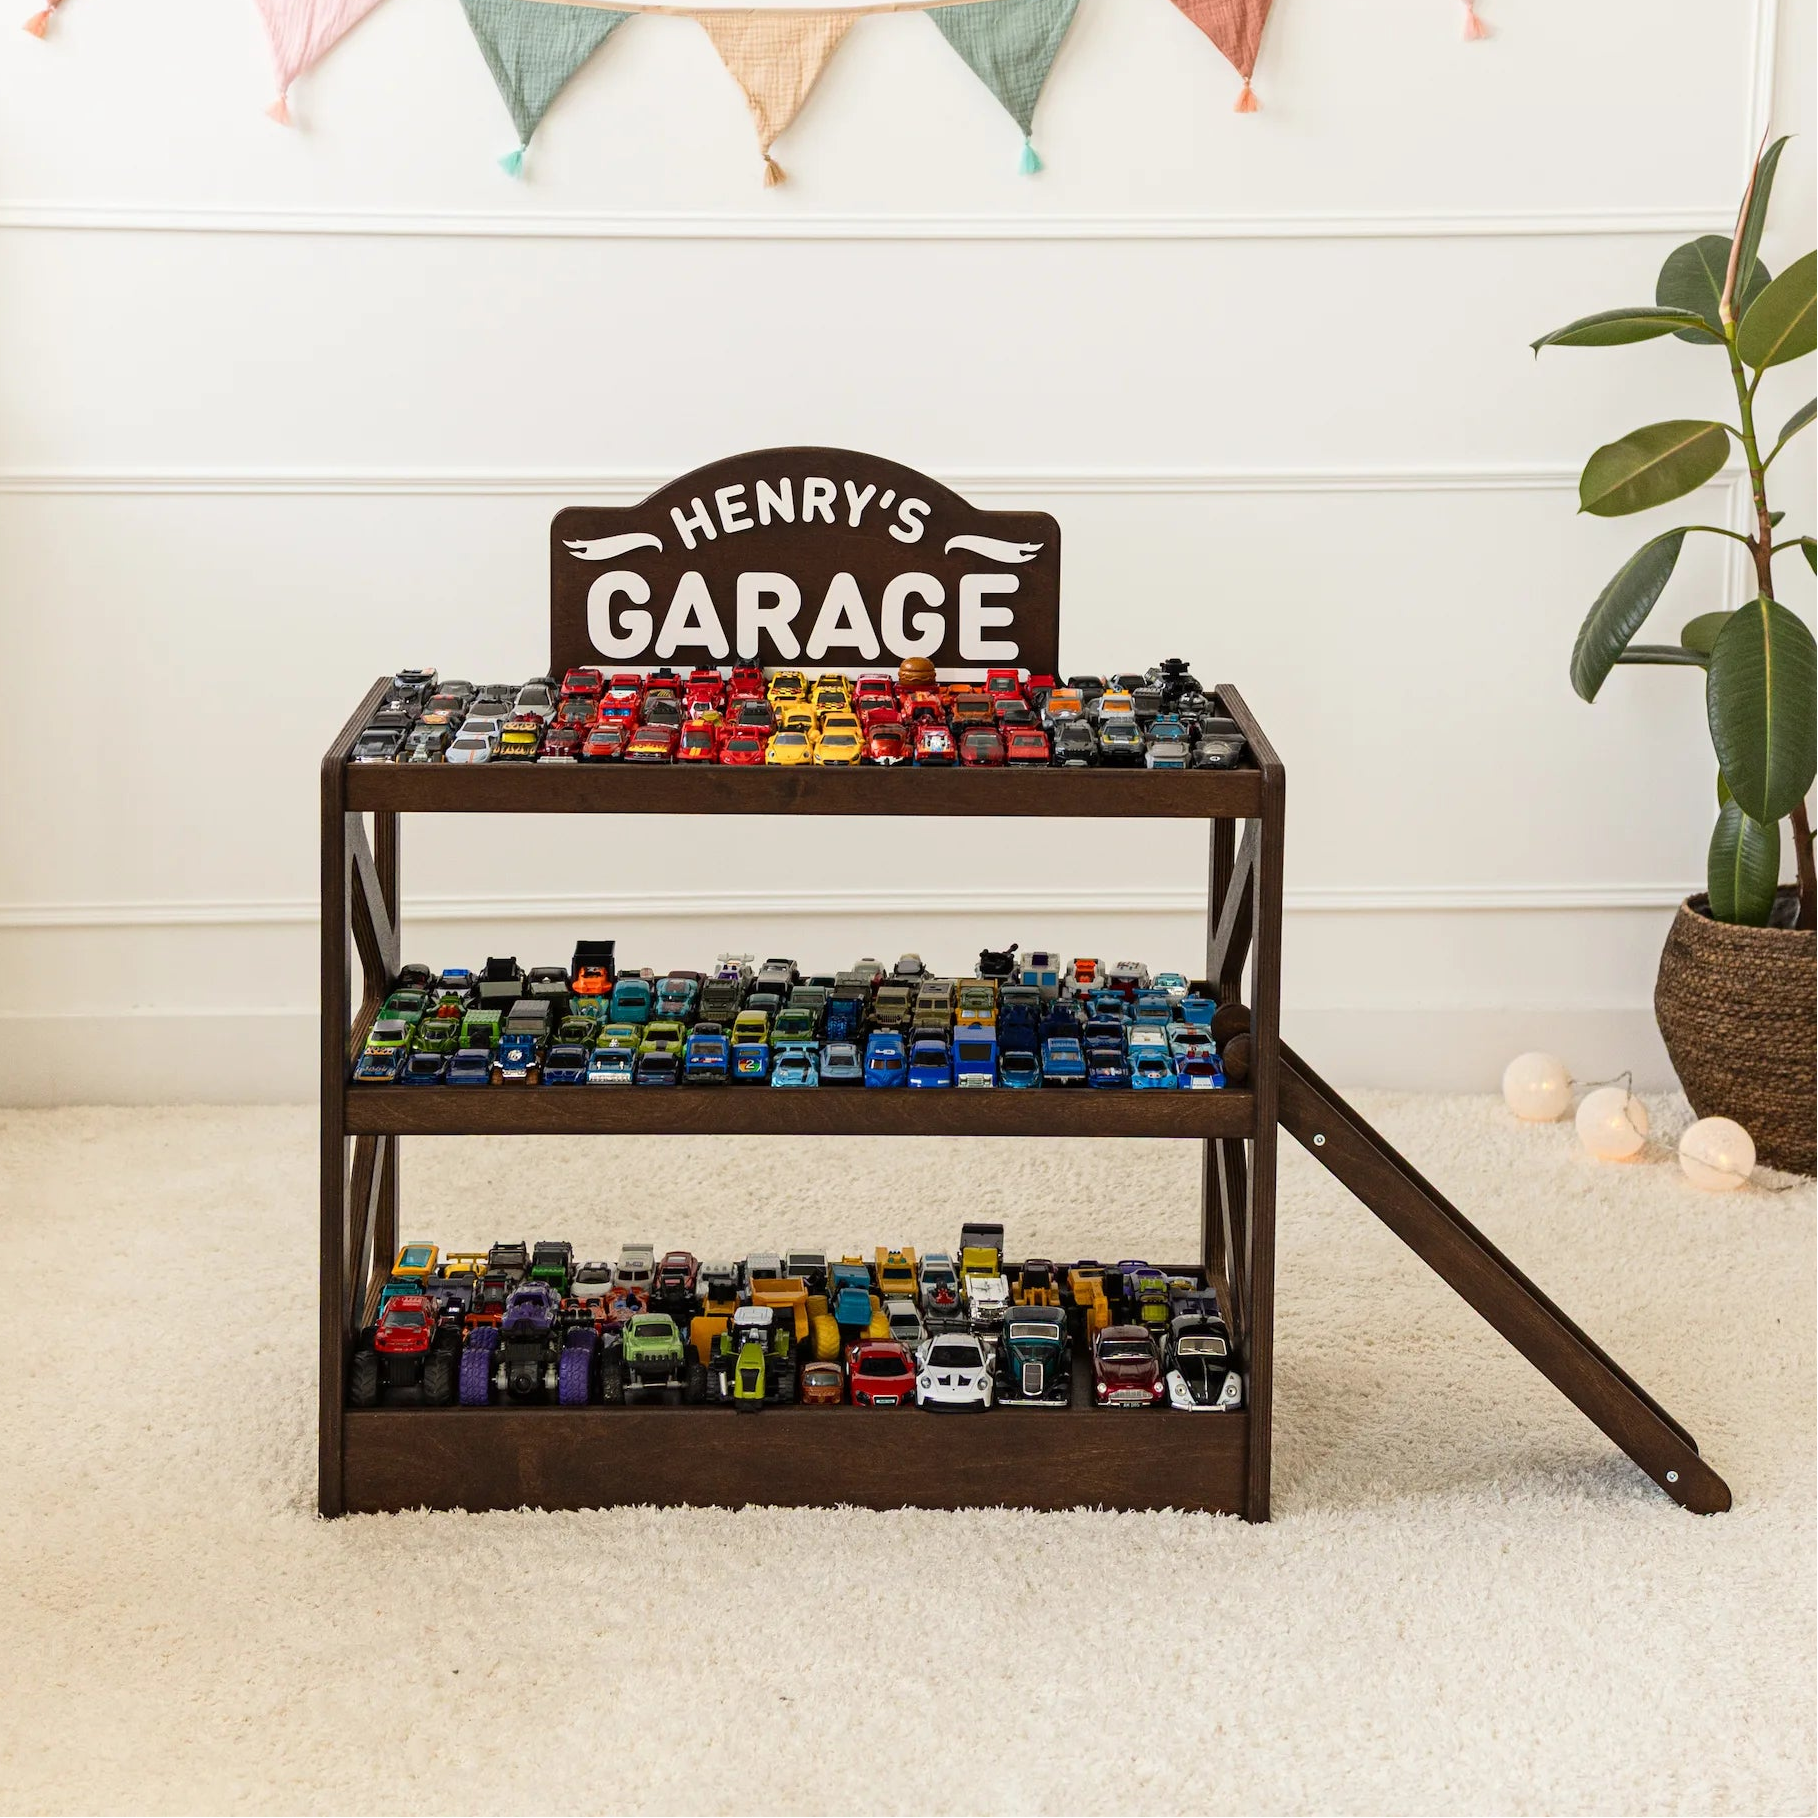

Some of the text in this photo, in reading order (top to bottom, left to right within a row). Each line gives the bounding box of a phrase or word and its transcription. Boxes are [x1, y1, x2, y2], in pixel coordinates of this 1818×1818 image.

[671, 477, 931, 550] HENRY'S
[587, 571, 1020, 661] GARAGE
[745, 1059, 755, 1069] 2
